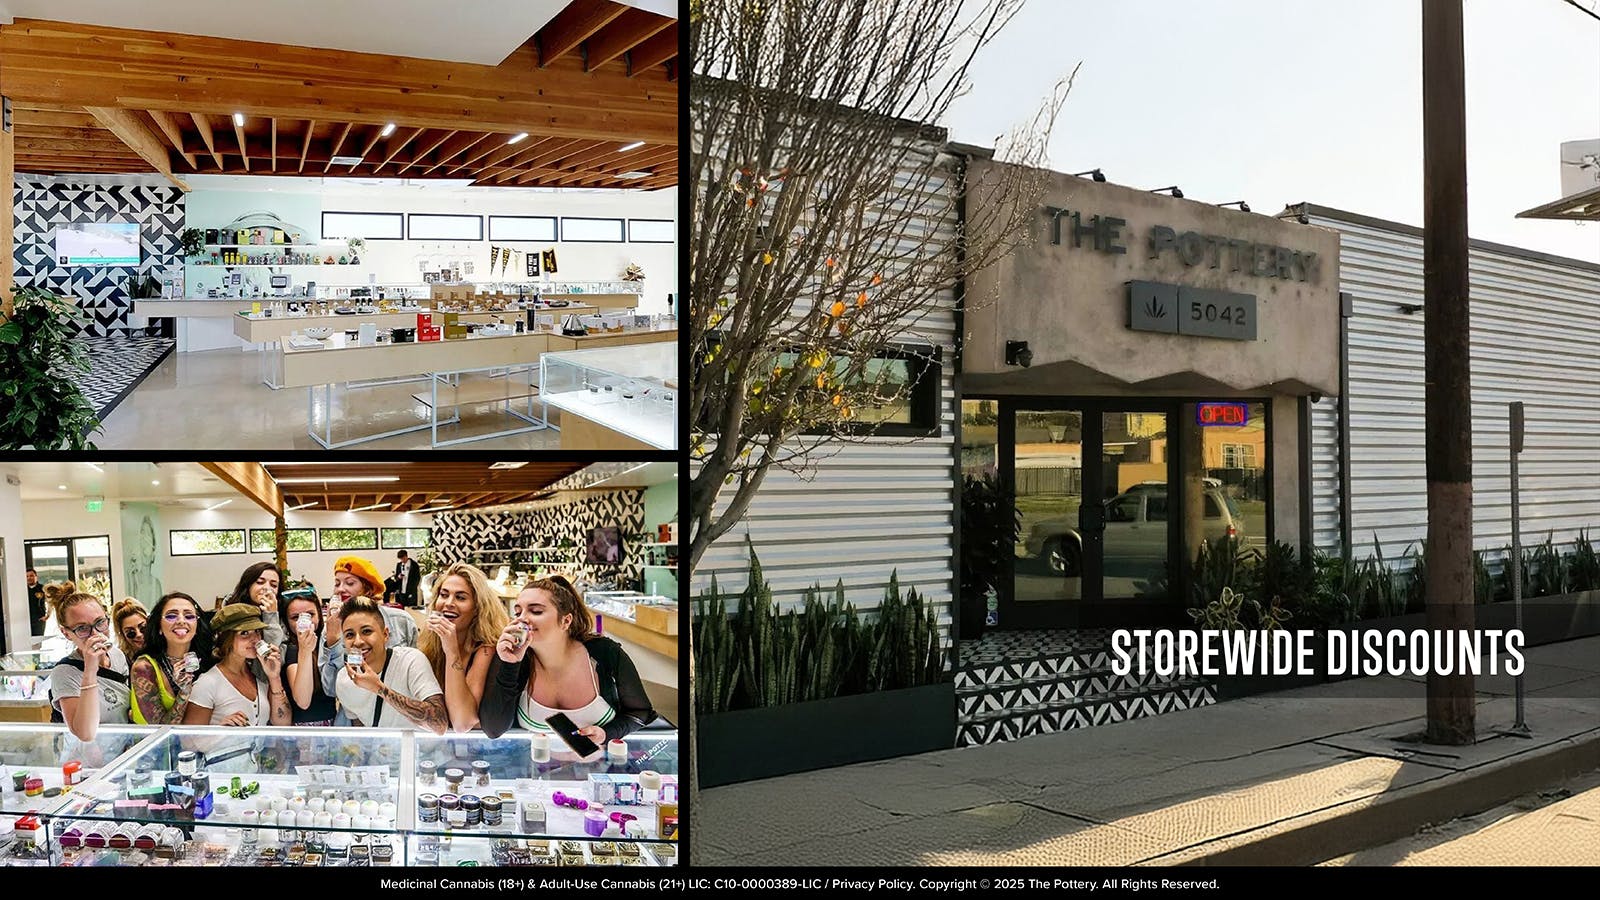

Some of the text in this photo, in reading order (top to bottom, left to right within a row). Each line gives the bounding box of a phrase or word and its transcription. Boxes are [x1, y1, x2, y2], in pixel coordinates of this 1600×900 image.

[1045, 205, 1318, 283] THE POTTERY
[1191, 302, 1246, 326] 5042
[1199, 404, 1245, 424] OPEN
[635, 753, 649, 765] THE
